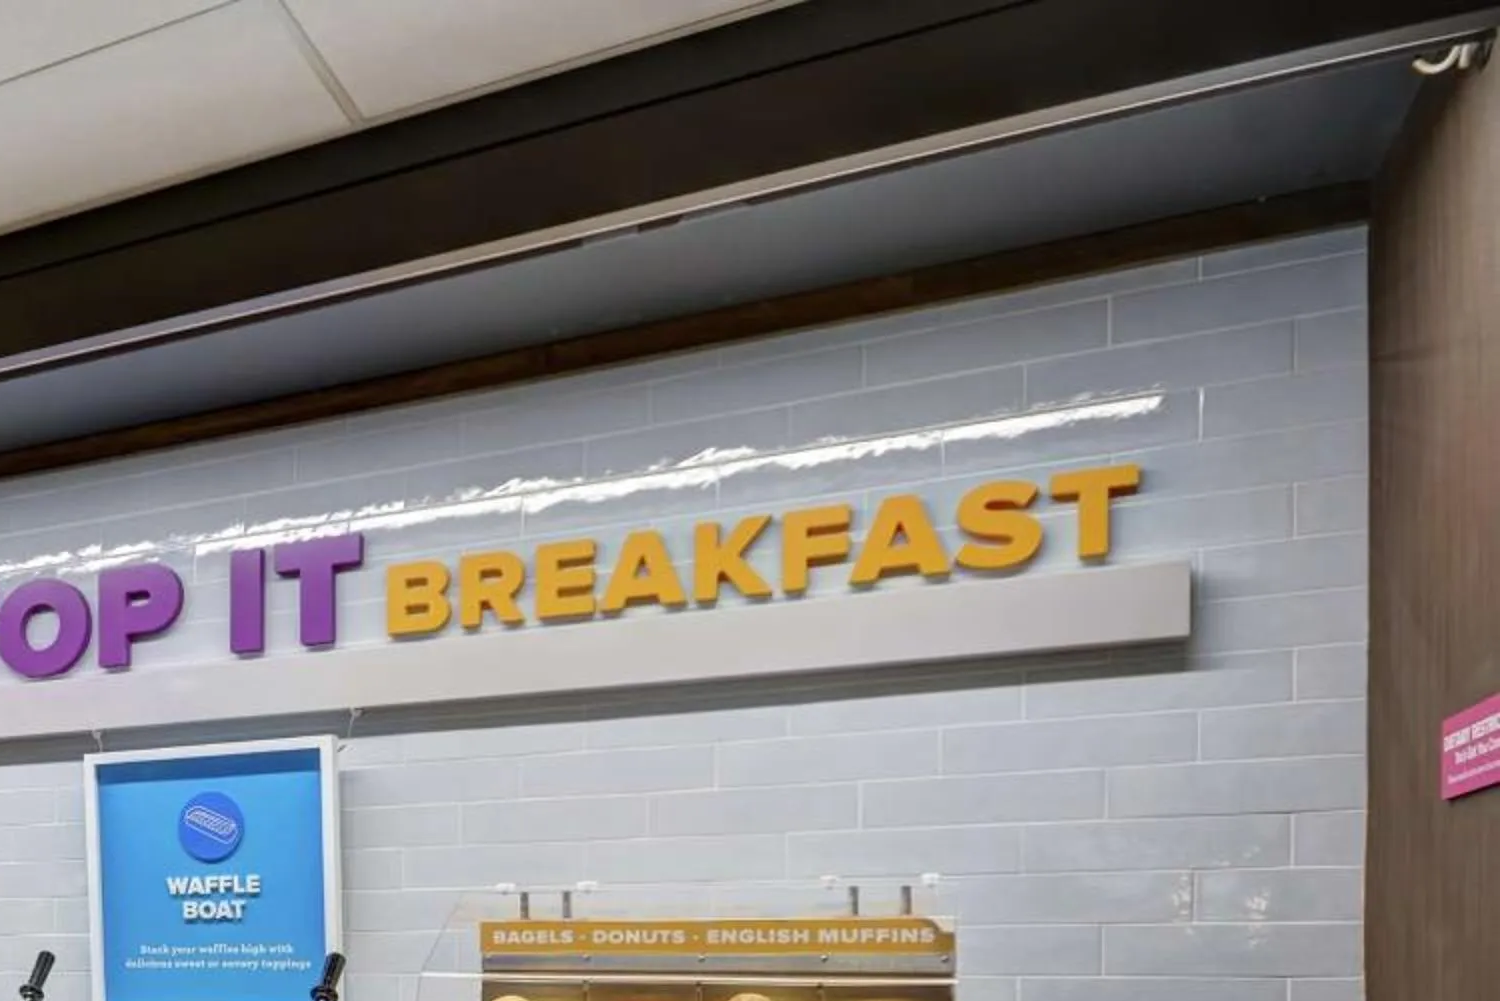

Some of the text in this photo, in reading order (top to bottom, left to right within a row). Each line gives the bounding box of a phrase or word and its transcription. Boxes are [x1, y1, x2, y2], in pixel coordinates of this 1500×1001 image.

[229, 532, 364, 656] IT
[386, 464, 1143, 638] BREAKFAST
[166, 874, 262, 897] WAFFLE
[182, 900, 247, 922] BOAT
[493, 926, 935, 945] BAGELS DONUTS ENGLISH MUFFINS
